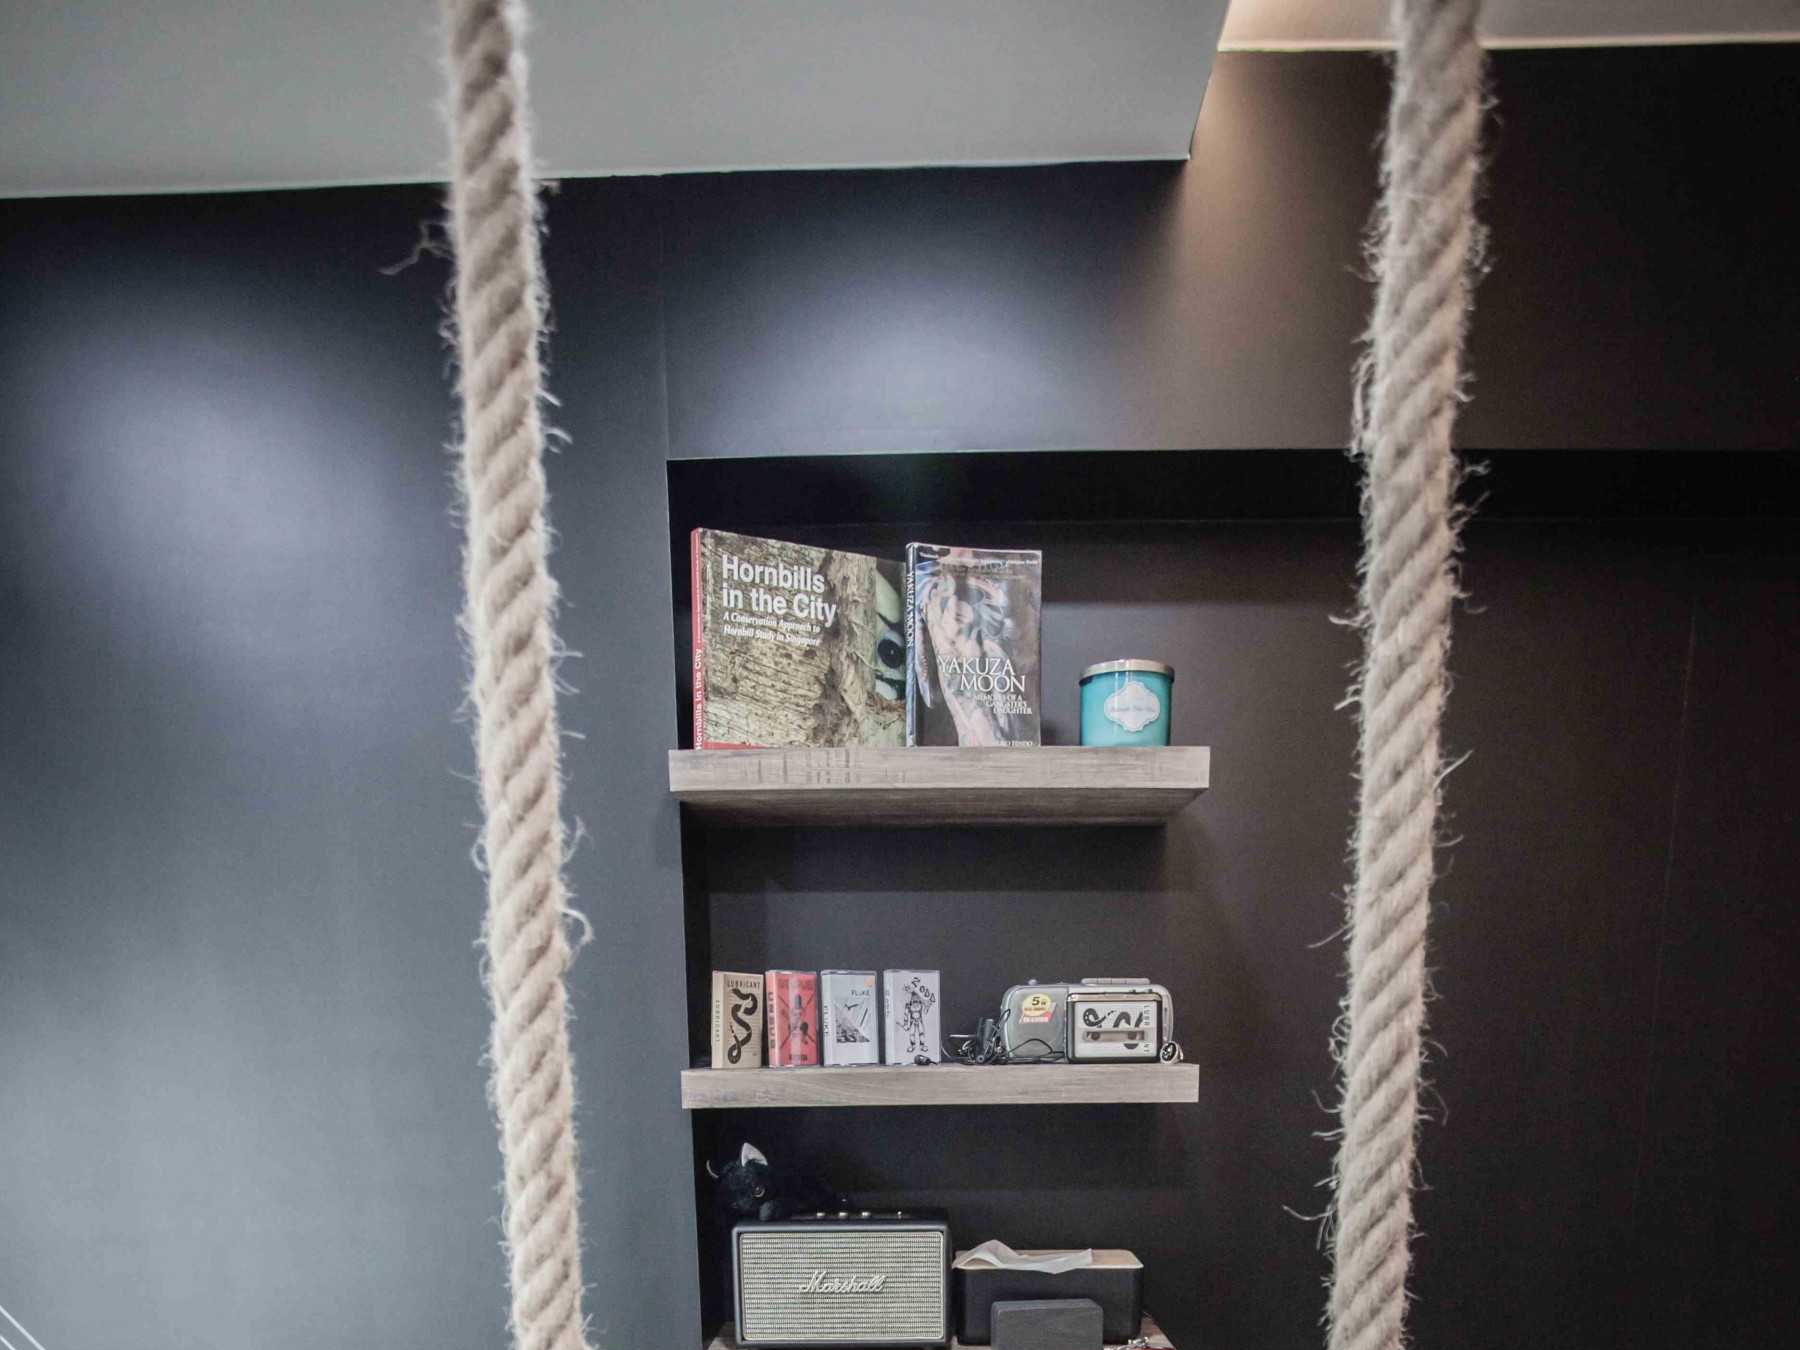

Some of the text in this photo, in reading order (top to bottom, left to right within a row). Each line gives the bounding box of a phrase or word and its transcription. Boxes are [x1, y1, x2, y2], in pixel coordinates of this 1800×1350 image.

[722, 554, 824, 593] Hornbills
[722, 582, 837, 628] in the City
[906, 572, 914, 648] YAKUZA MOON
[723, 611, 821, 633] A Conservation Approach to
[723, 624, 754, 638] Hornbill
[755, 628, 775, 641] Study
[695, 648, 703, 669] City
[938, 655, 1016, 675] YAKUZA
[960, 674, 1026, 693] MOON
[695, 704, 703, 749] Hornbills
[727, 979, 761, 989] LUBRICANT
[799, 1270, 887, 1293] Marshall
